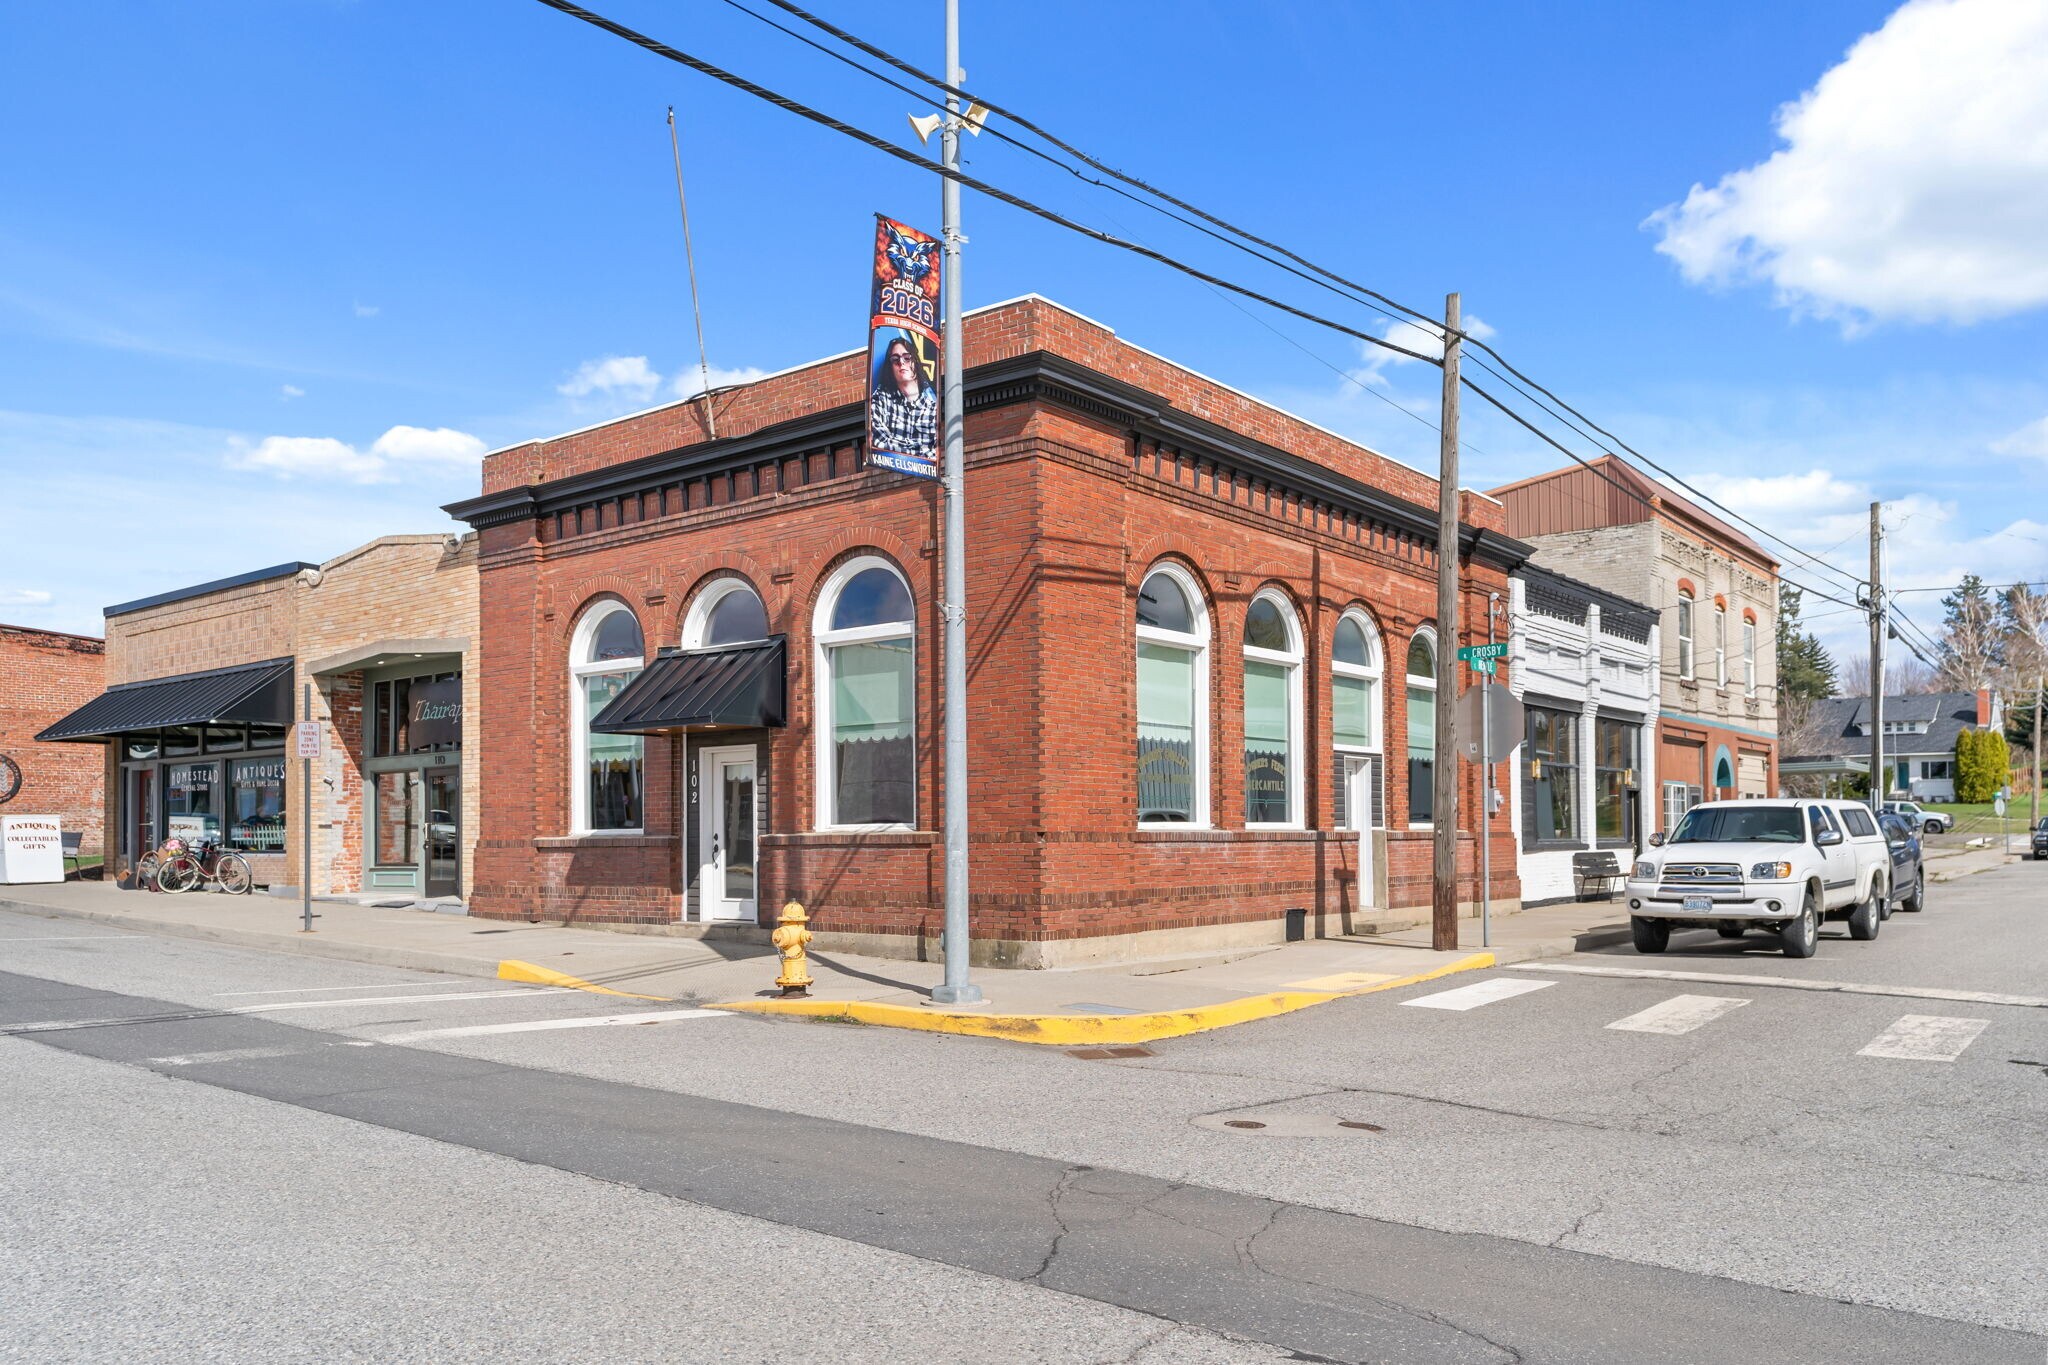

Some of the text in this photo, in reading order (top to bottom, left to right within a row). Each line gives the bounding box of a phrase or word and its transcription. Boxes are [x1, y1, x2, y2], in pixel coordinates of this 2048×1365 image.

[893, 279, 924, 297] CLASS OF
[881, 286, 934, 328] 2026
[872, 453, 937, 477] KAINE ELLSWORTH
[1471, 645, 1502, 658] CROSBY
[171, 769, 219, 786] HOMESTEAD
[235, 764, 285, 782] ANTIQUES
[181, 783, 208, 792] GENERAL STORE
[240, 781, 252, 789] GIFTS
[10, 822, 57, 831] ANTIQUES
